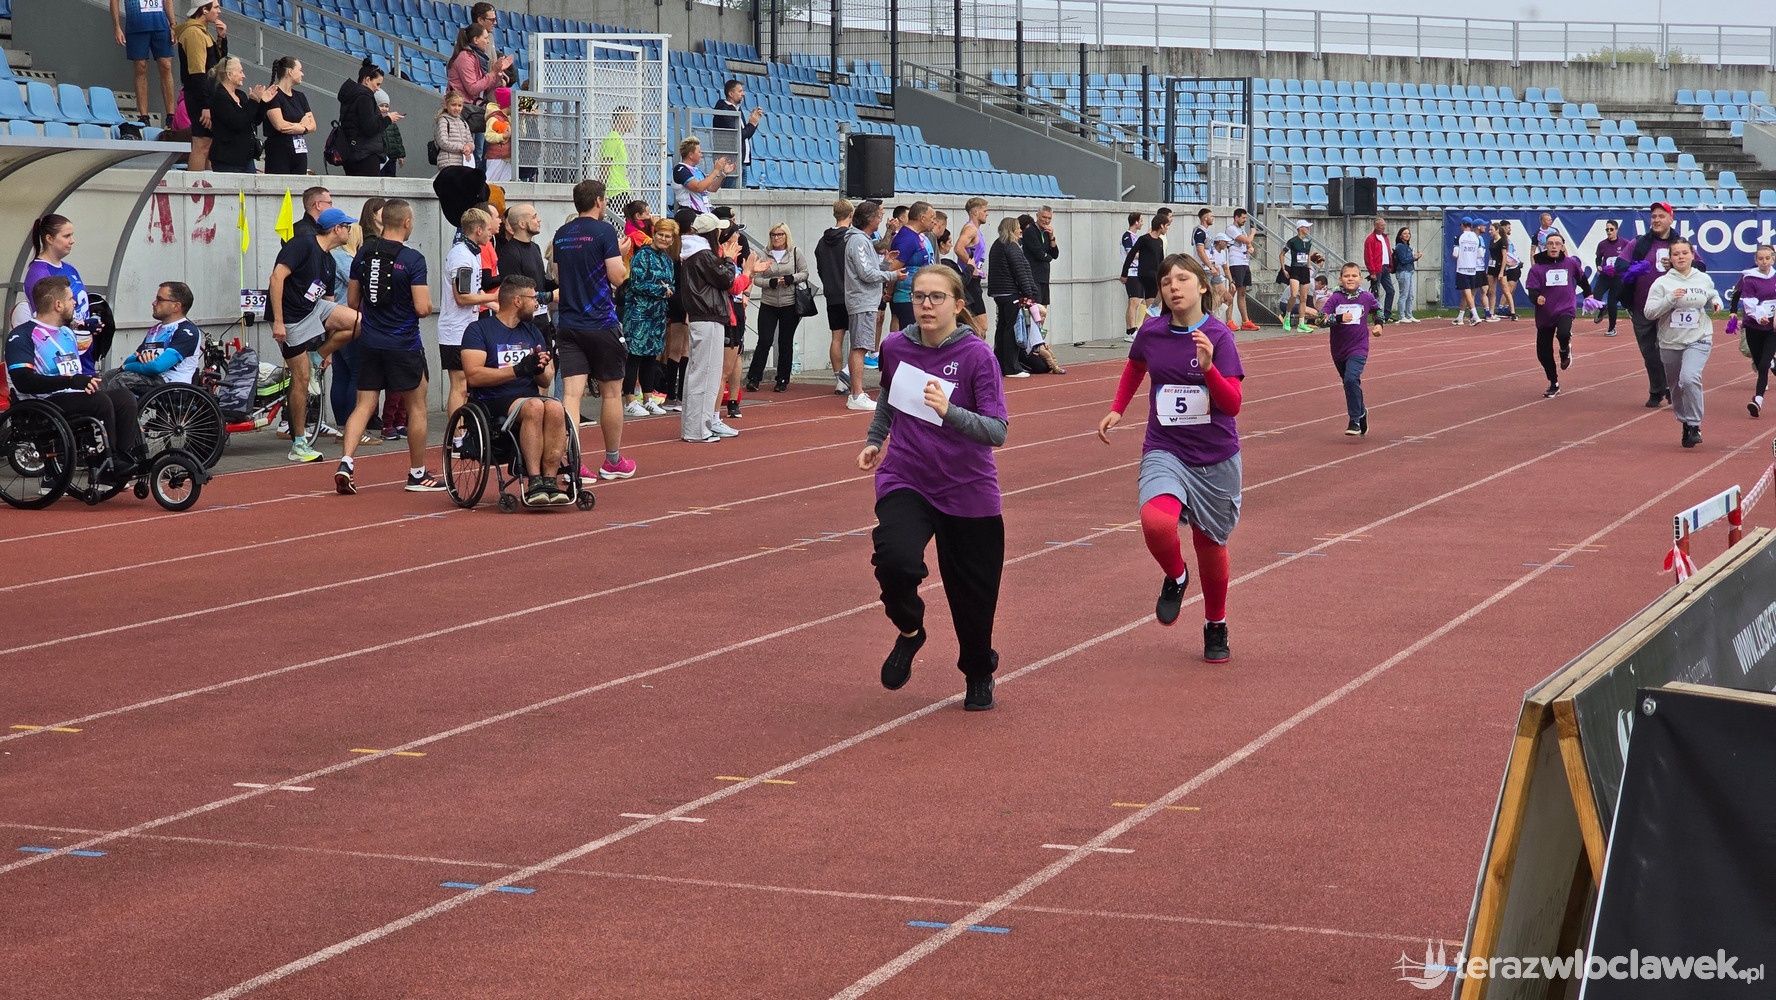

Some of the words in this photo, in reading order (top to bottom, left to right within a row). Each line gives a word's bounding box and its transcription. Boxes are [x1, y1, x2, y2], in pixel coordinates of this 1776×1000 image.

[370, 259, 381, 303] OUTDOOR
[245, 295, 266, 305] 539
[1679, 313, 1692, 322] 16
[61, 361, 79, 373] 728
[1175, 397, 1188, 414] 5
